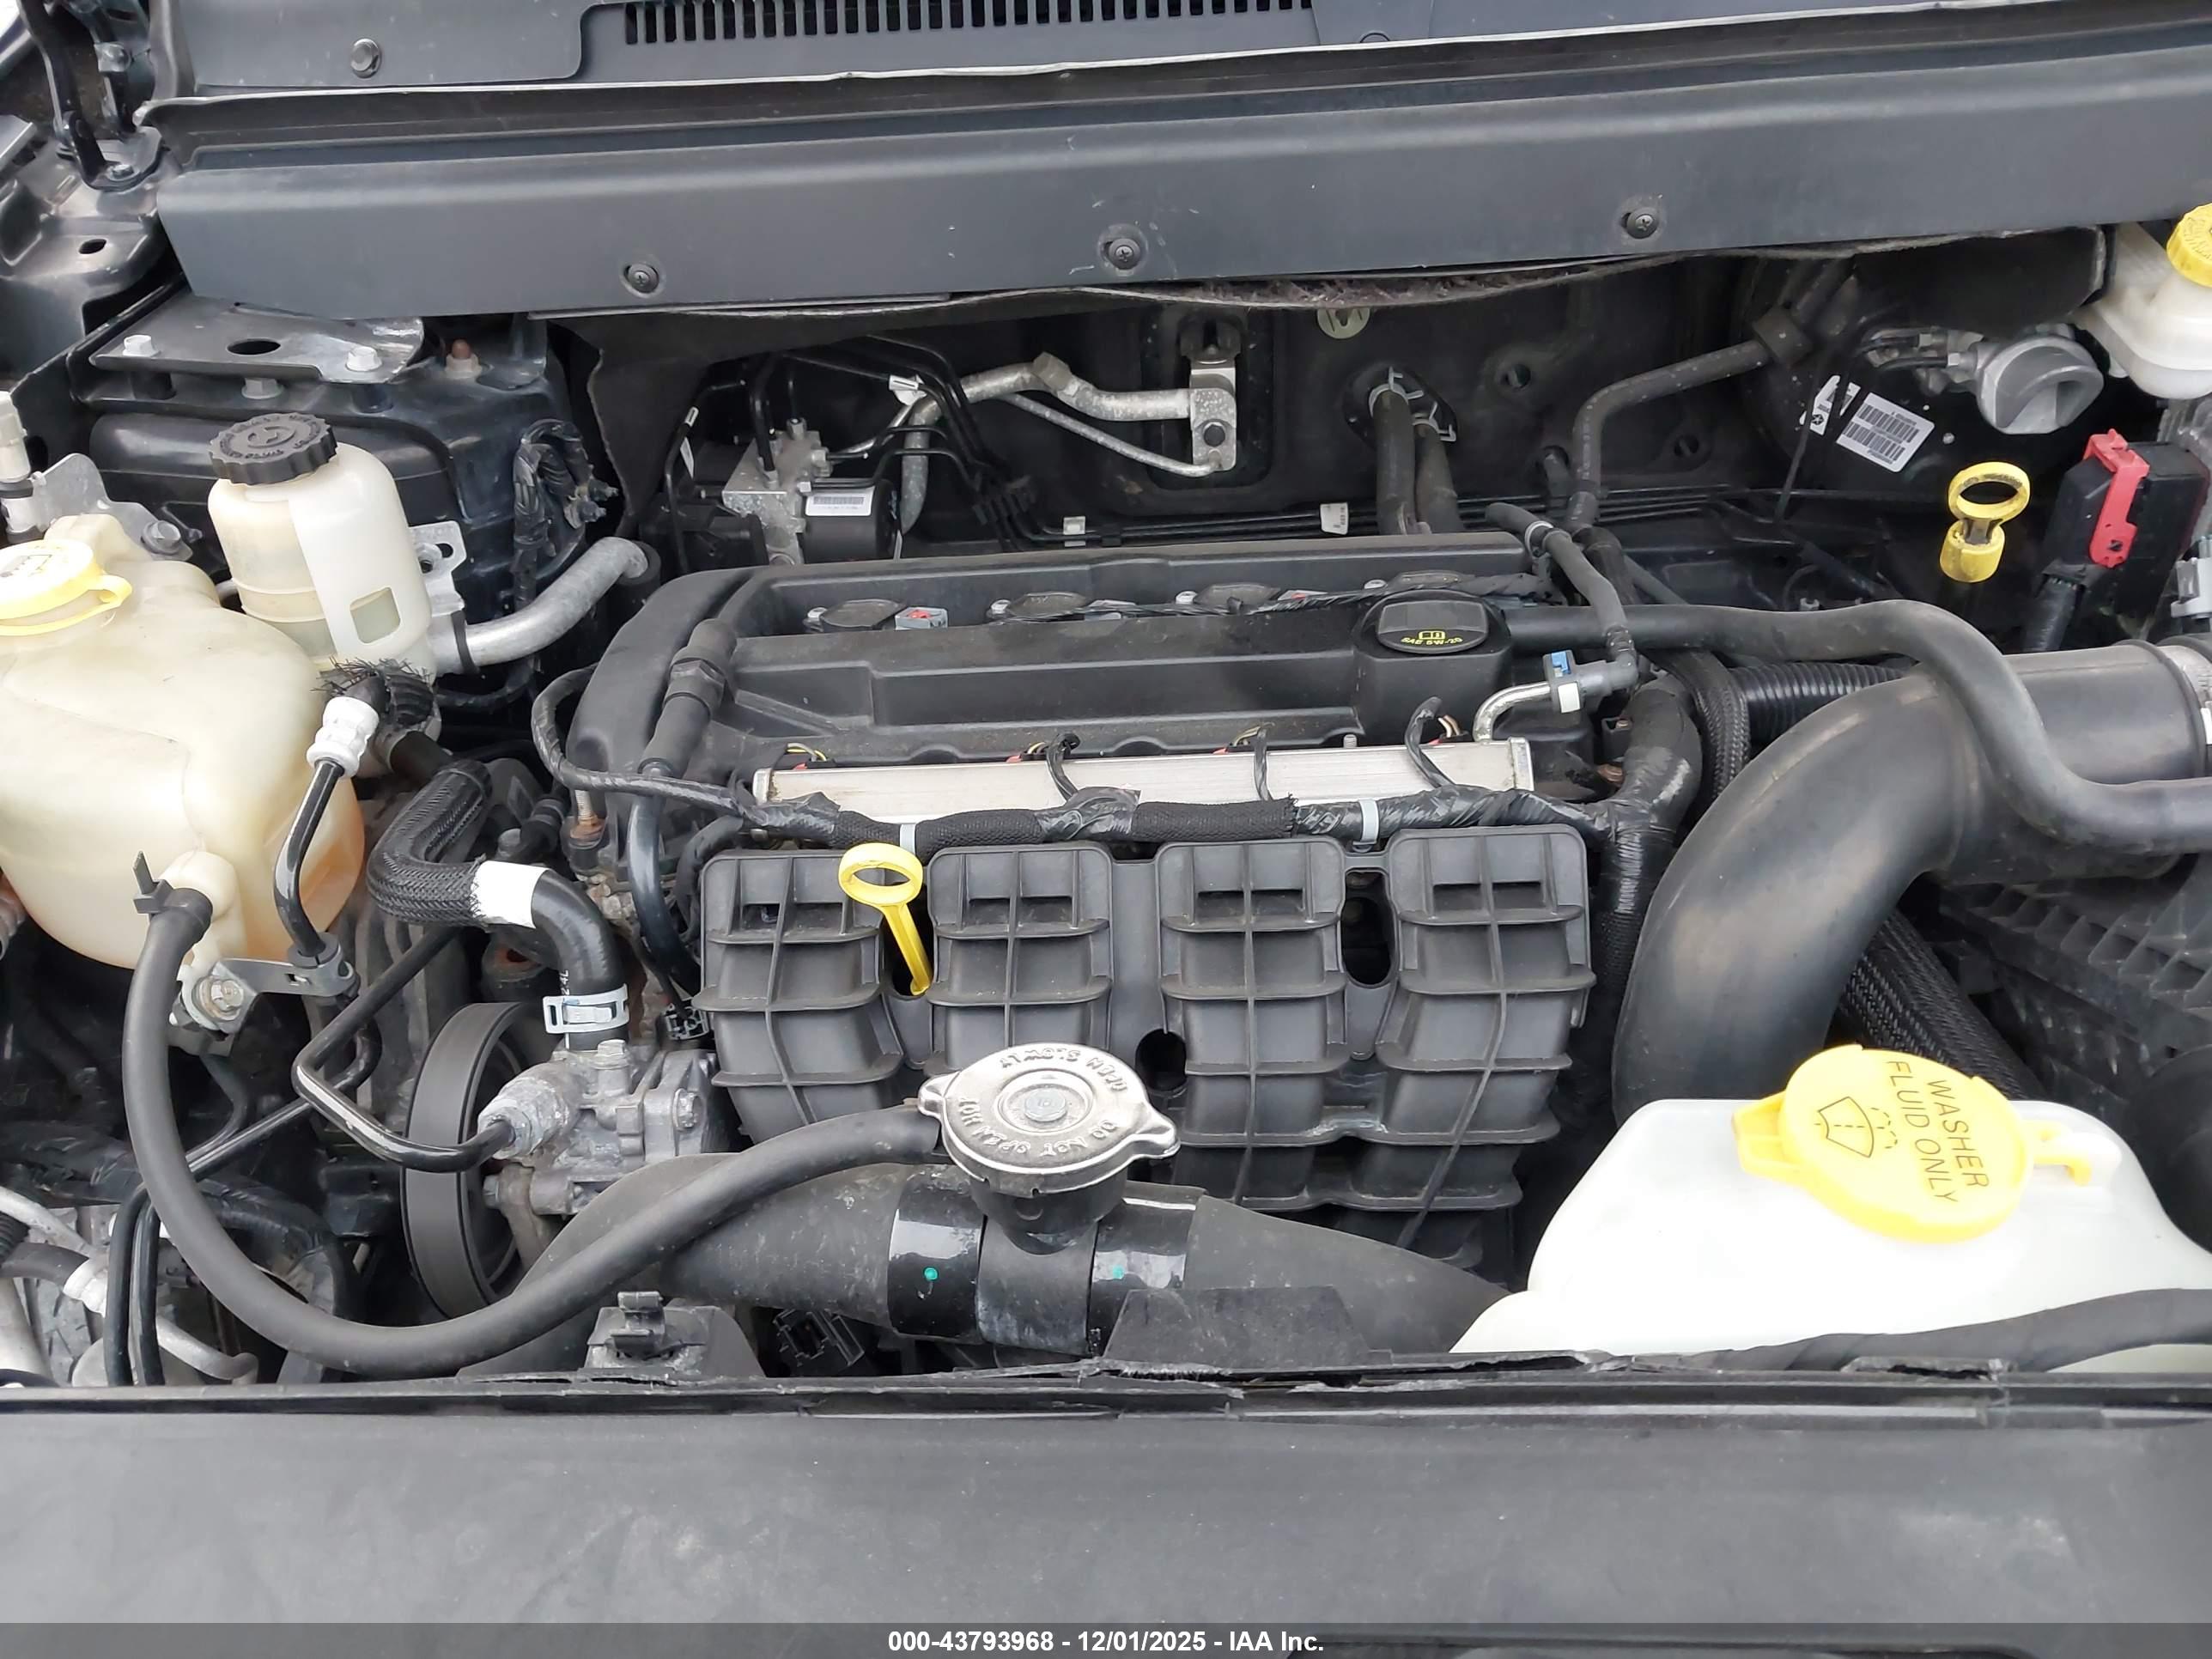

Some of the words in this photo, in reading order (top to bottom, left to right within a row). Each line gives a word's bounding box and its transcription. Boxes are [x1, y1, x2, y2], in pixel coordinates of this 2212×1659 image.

[1085, 1057, 1127, 1091] OPEN
[958, 1097, 983, 1127] HOT
[971, 1126, 1031, 1154] OPEN
[1091, 1119, 1118, 1139] DO
[1887, 1060, 1930, 1128] FLUID
[1914, 1138, 1959, 1202] ONLY
[1927, 1079, 1990, 1187] WASHER
[1039, 1136, 1088, 1158] NOT
